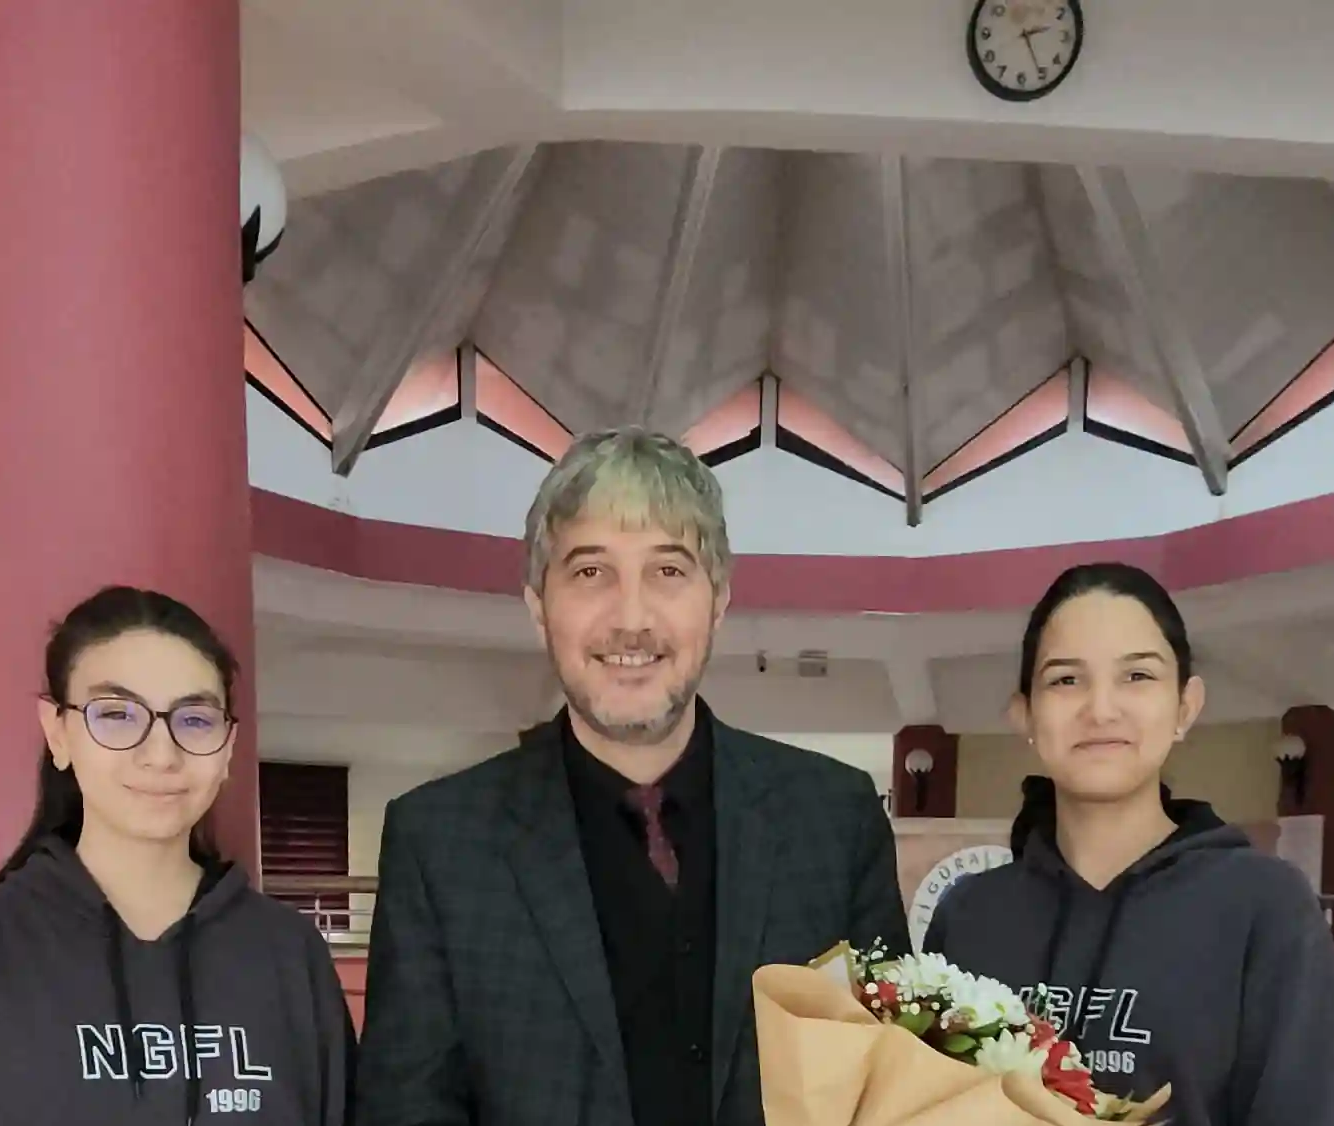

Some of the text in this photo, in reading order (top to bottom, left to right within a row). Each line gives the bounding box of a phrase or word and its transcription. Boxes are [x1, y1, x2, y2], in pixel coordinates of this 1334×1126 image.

[997, 65, 1007, 79] 7
[75, 1023, 273, 1081] NGFL
[1085, 1050, 1136, 1074] 1996
[205, 1088, 263, 1113] 1996
